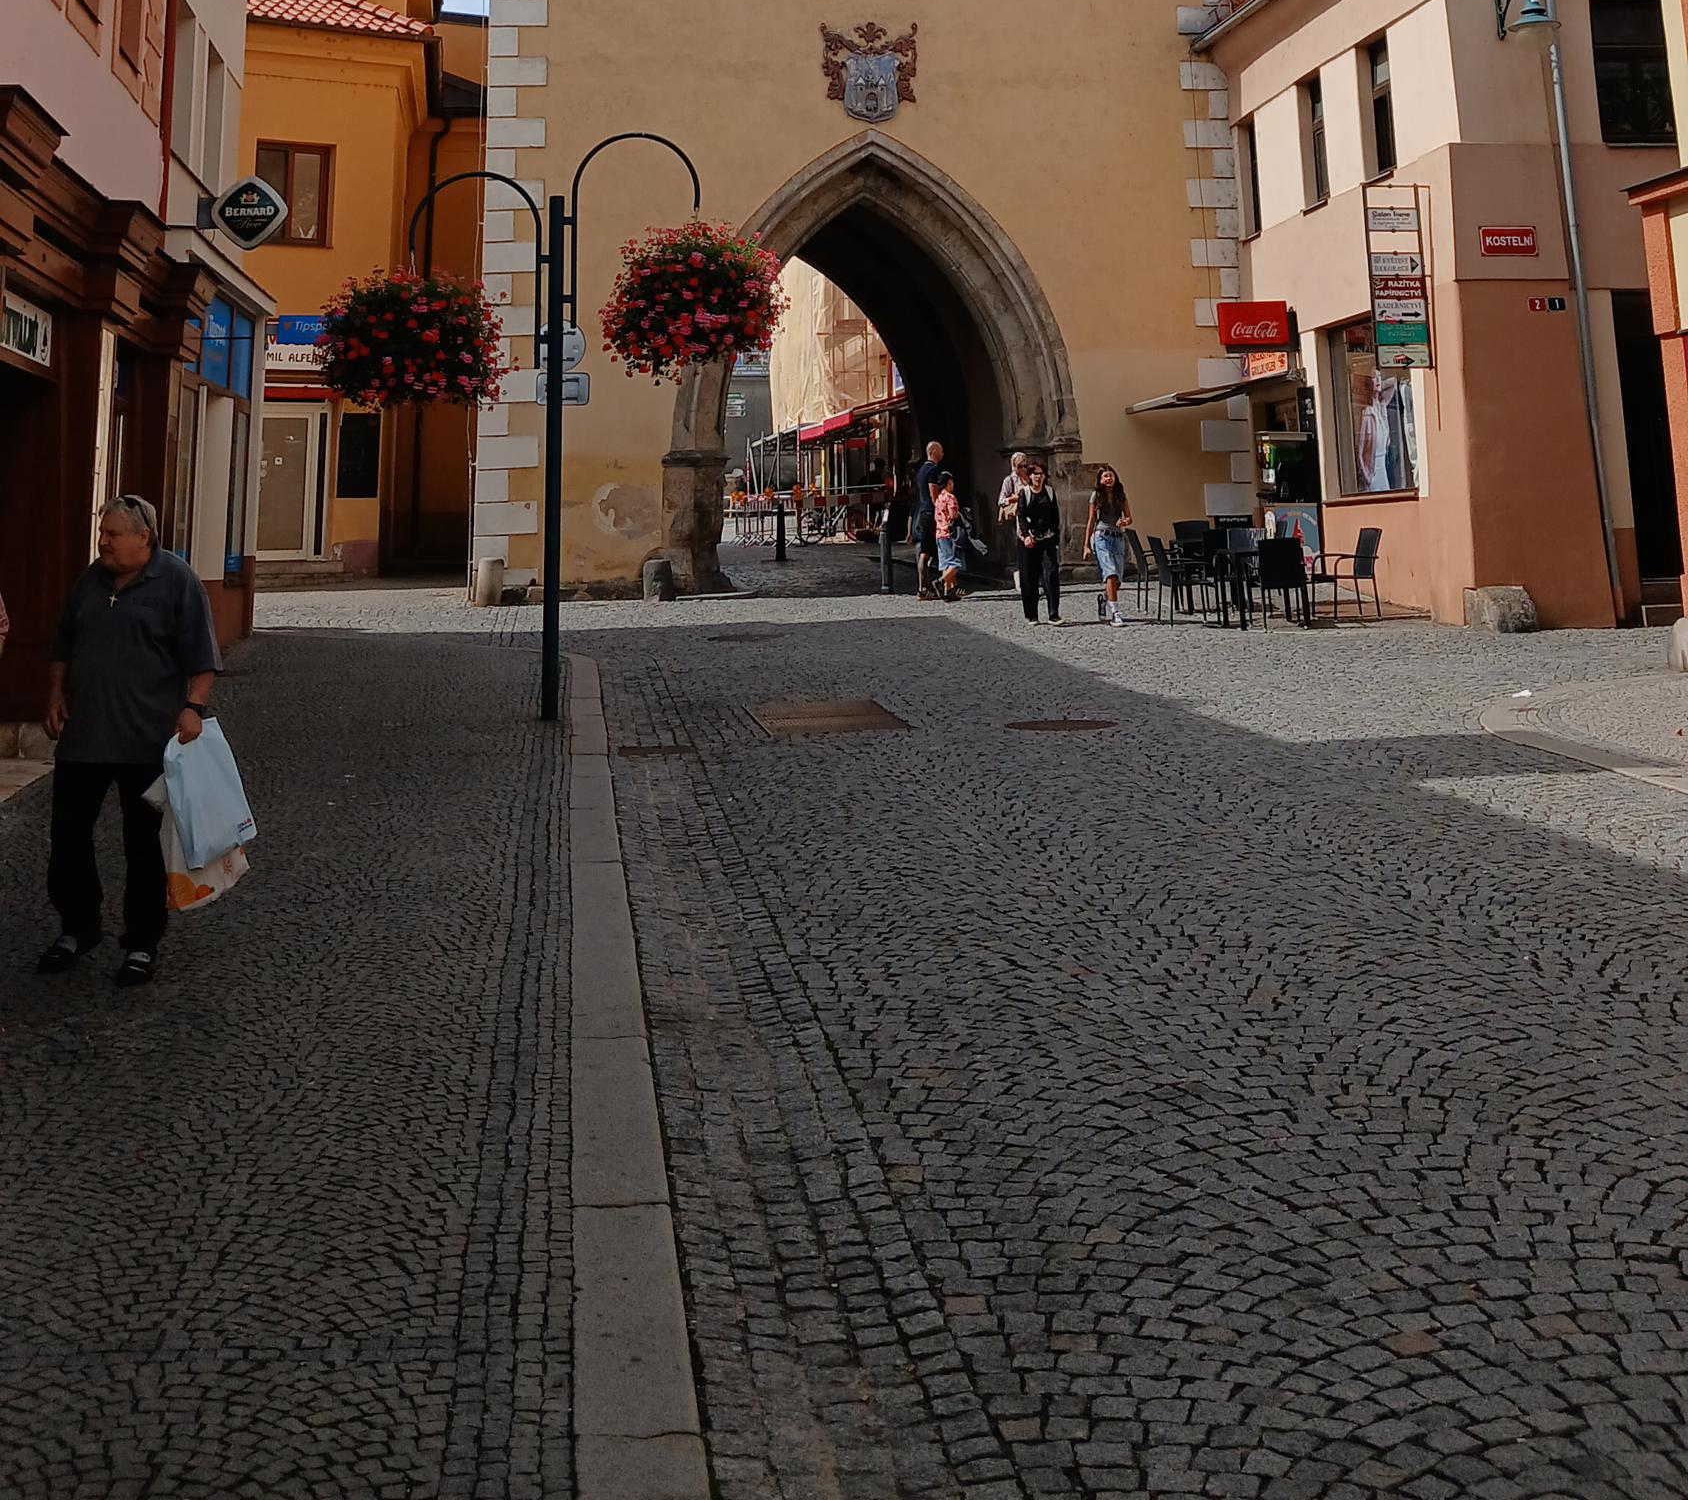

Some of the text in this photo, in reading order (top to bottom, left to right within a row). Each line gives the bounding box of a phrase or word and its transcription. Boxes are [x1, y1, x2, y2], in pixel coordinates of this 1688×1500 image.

[225, 205, 275, 217] BERNARD
[1485, 234, 1533, 246] KOSTELNÍ
[1388, 279, 1421, 288] RAZÍTKA
[1534, 299, 1540, 310] 2
[1231, 321, 1279, 339] Coca-Cola
